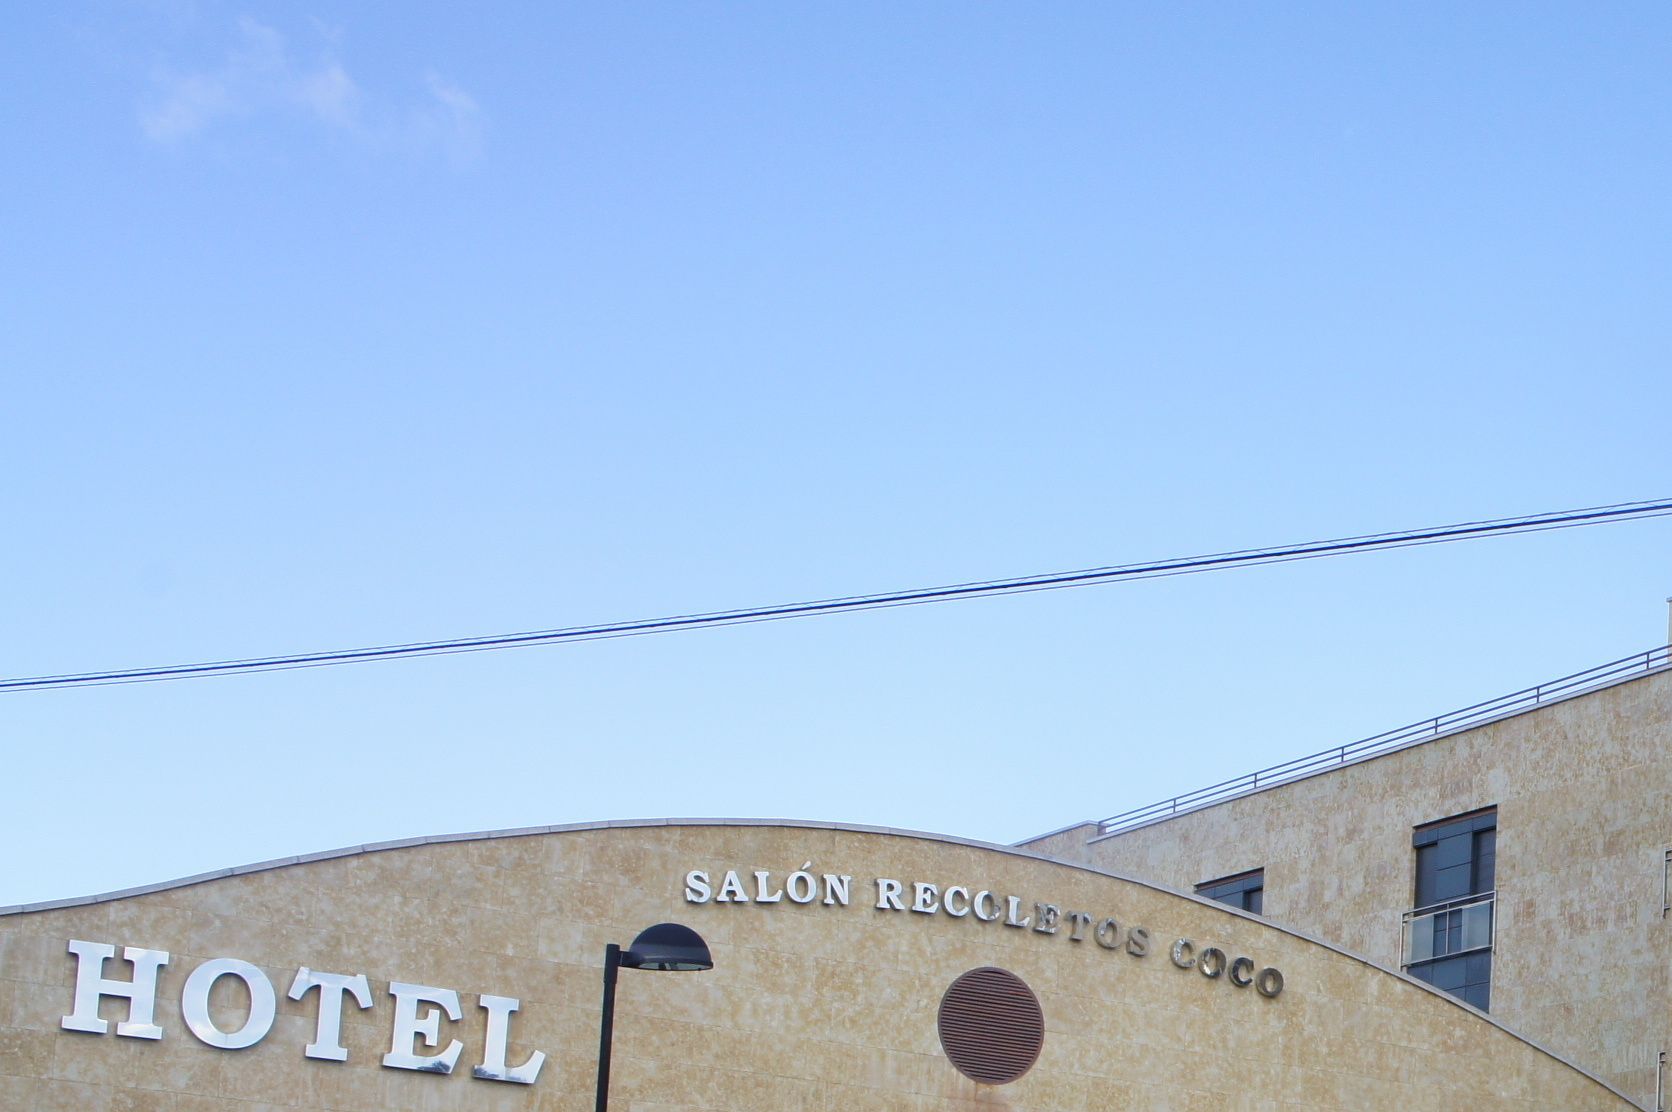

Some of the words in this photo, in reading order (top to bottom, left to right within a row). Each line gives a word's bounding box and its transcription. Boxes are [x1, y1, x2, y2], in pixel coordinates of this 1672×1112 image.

[685, 861, 851, 905] SALÓN
[876, 879, 1151, 957] RECOLETOS
[1170, 937, 1285, 998] COCO
[61, 939, 546, 1085] HOTEL
